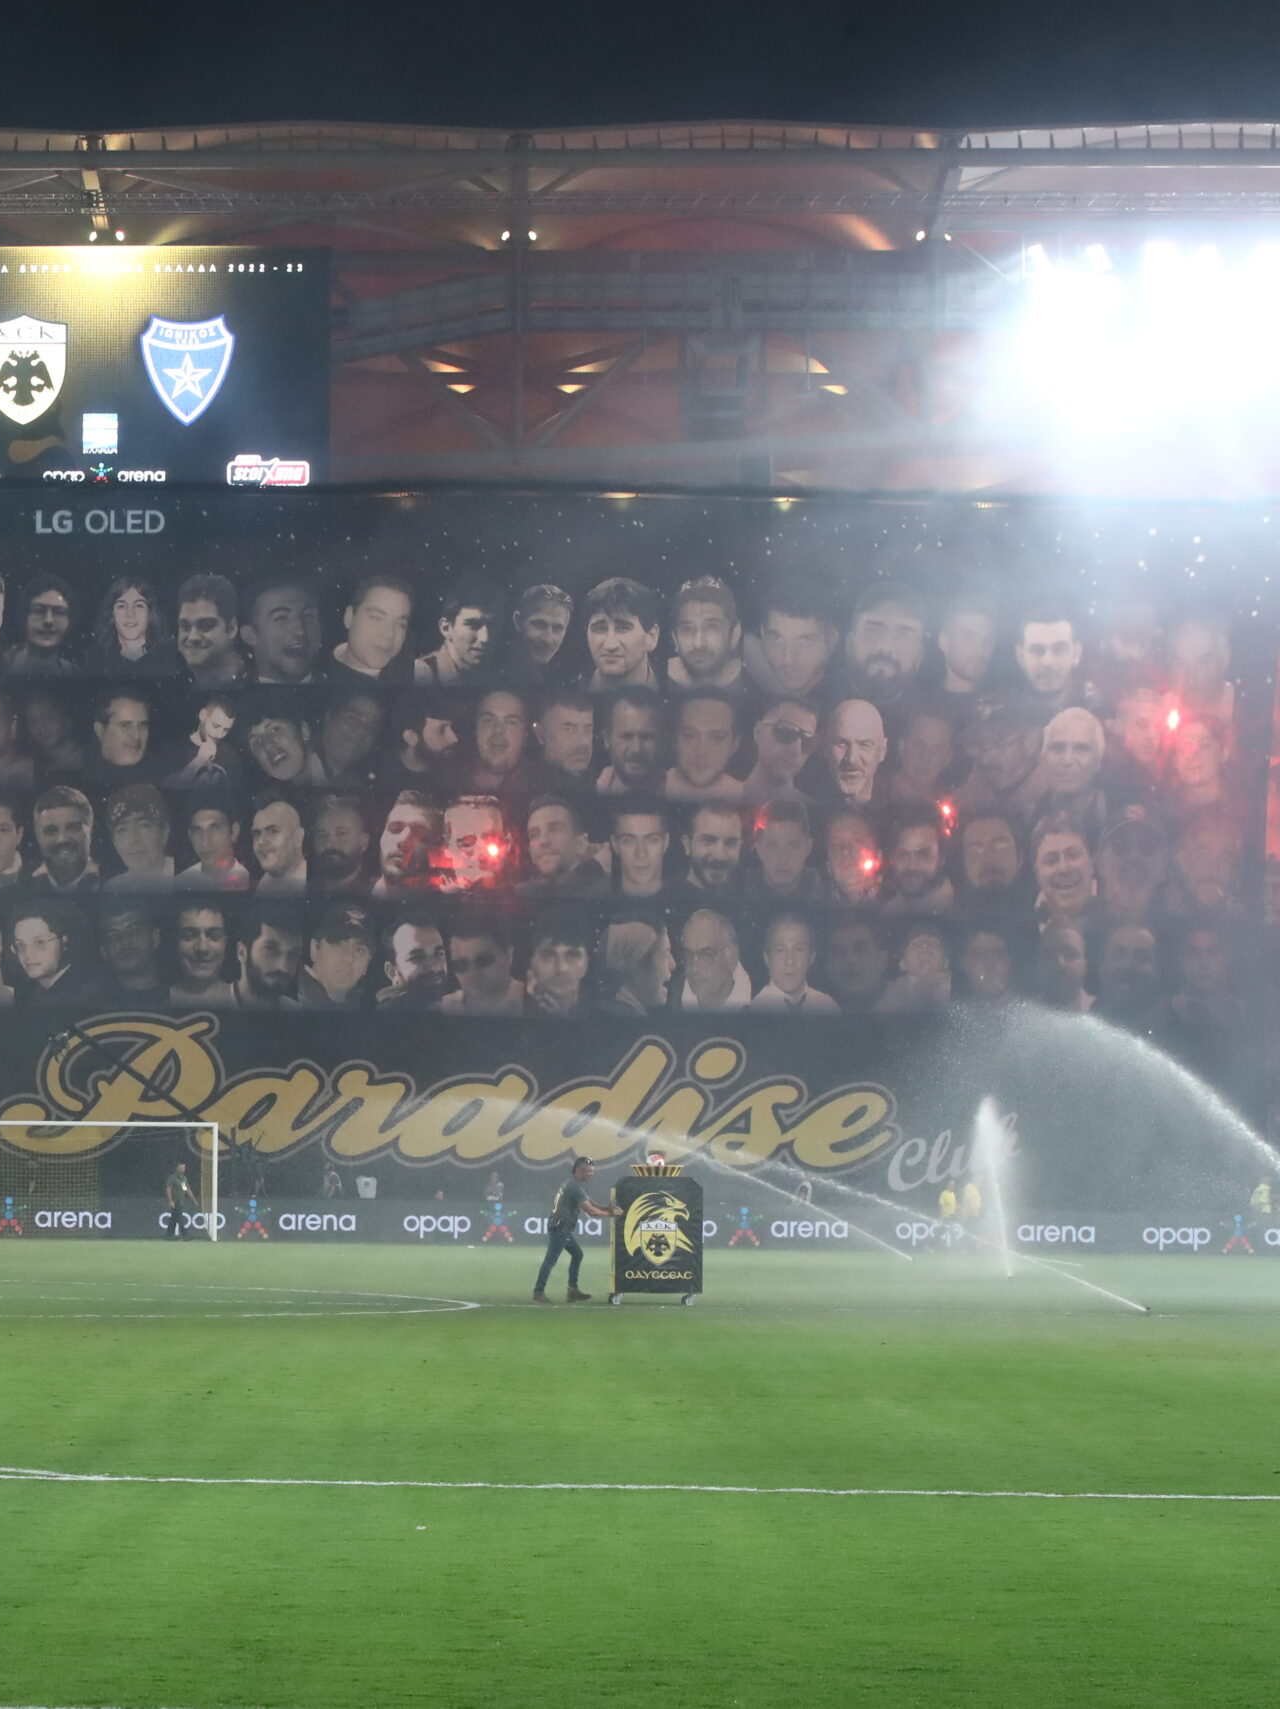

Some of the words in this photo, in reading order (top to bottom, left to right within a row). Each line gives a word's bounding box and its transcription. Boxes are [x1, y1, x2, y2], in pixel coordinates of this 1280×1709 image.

[228, 264, 266, 273] 2022
[286, 264, 304, 273] 23
[117, 470, 166, 482] arena
[35, 509, 73, 534] LG
[84, 509, 166, 534] OLED
[887, 1112, 1020, 1192] Clu
[35, 1210, 112, 1229] arena
[279, 1213, 356, 1232] arena
[403, 1215, 471, 1239] opap
[524, 1217, 602, 1236] arna
[771, 1219, 849, 1239] arena
[1018, 1224, 1096, 1243] arena
[1142, 1227, 1211, 1251] opap
